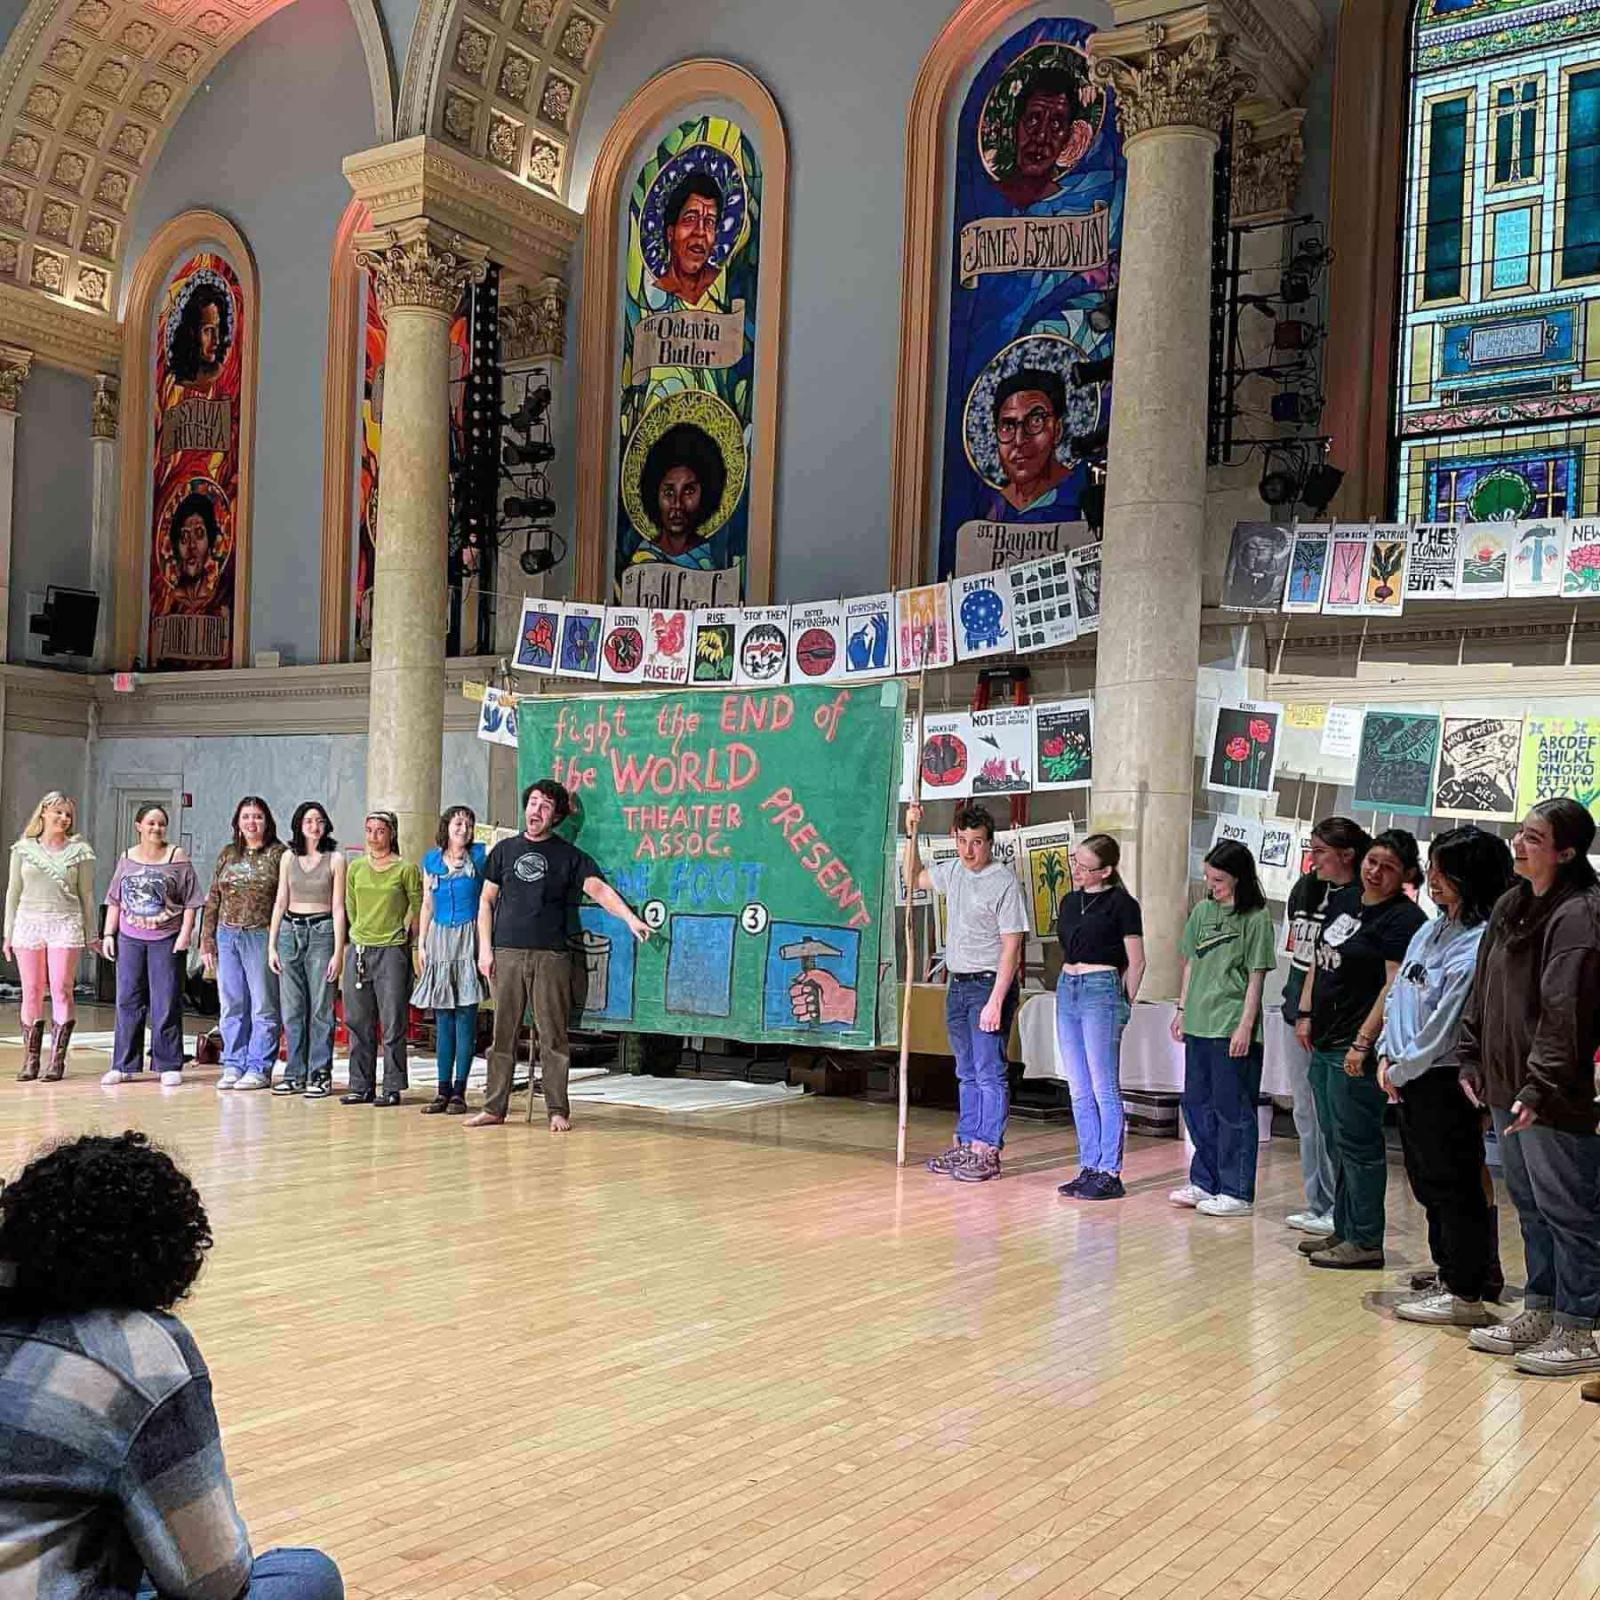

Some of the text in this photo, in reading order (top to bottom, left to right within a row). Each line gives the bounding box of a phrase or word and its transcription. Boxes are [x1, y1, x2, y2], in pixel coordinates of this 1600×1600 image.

[964, 215, 1106, 273] JAMES BALDWIN
[657, 316, 720, 342] Octavia
[659, 341, 716, 366] Butler
[993, 524, 1061, 559] Bayard
[1415, 528, 1450, 545] THE
[962, 576, 995, 593] EARTH
[706, 612, 726, 624] RISE
[847, 600, 888, 614] UPRISING
[614, 615, 639, 627] LISTEN
[643, 664, 686, 680] RISE UP
[553, 701, 629, 757] fight
[655, 702, 702, 758] the
[720, 693, 795, 733] END
[813, 689, 852, 743] of
[972, 714, 995, 728] NOT
[1444, 732, 1464, 749] WHO
[1466, 720, 1503, 741] PROFITS
[1538, 735, 1597, 749] ABCDEF
[551, 741, 762, 796] the WORLD
[1467, 774, 1489, 784] WHO
[622, 803, 743, 833] THEATER
[1222, 824, 1247, 840] RIOT
[633, 832, 733, 860] ASSOC.
[757, 786, 872, 929] PRESENT
[668, 861, 768, 904] FOOT
[648, 906, 661, 923] 2
[746, 906, 760, 930] 3
